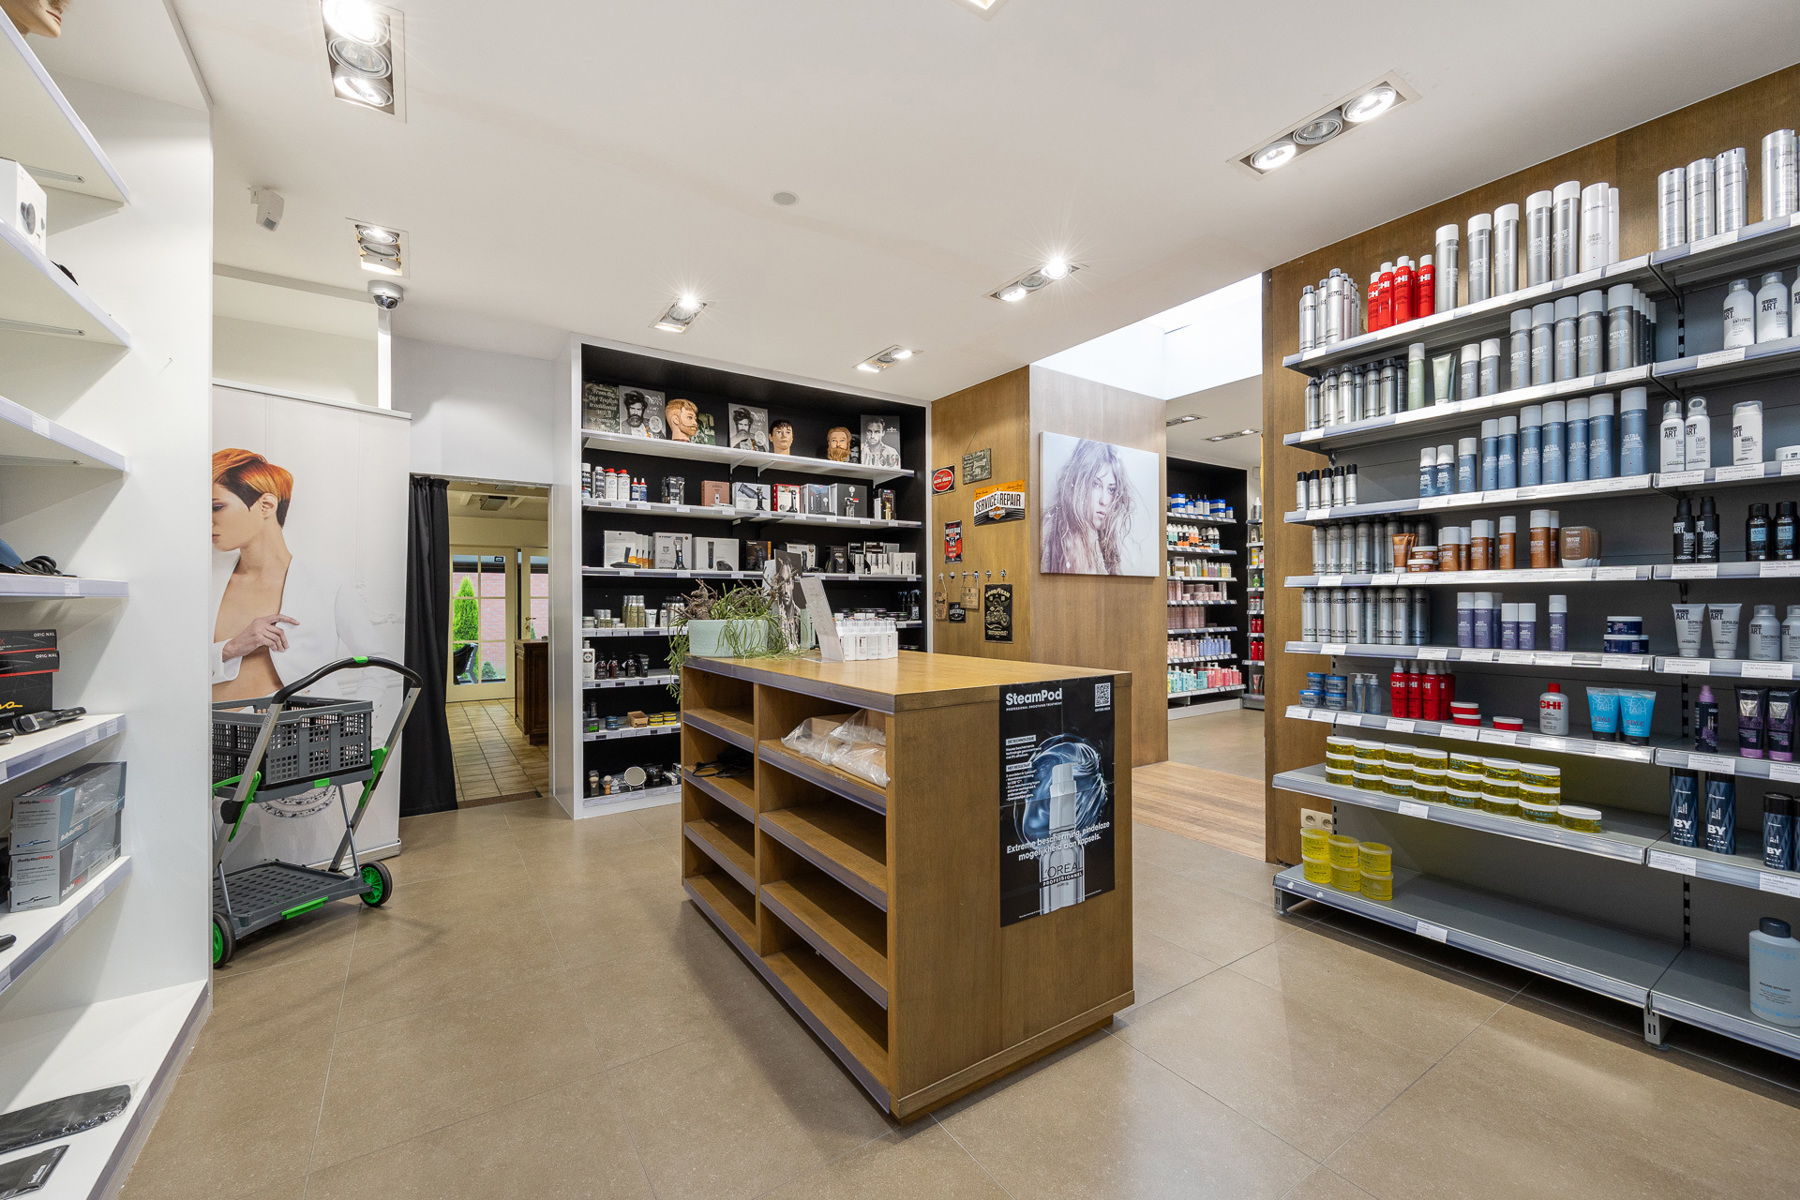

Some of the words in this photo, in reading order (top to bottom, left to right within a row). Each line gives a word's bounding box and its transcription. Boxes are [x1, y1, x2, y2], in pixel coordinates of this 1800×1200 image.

[1394, 275, 1408, 285] CHI
[975, 493, 997, 514] SERVICE
[1000, 492, 1021, 507] REPAIR
[1006, 687, 1063, 706] SteamPod
[1592, 695, 1615, 704] SEXY
[1540, 700, 1562, 710] CHI
[1625, 697, 1649, 707] SEXY
[1592, 703, 1615, 712] HAIR
[1624, 706, 1647, 715] HAIR
[1594, 715, 1611, 723] STYLE
[1626, 719, 1643, 727] STYLE
[1673, 818, 1692, 829] BY
[1707, 824, 1726, 835] BY
[1006, 841, 1036, 854] Extreme
[1037, 830, 1082, 845] bescherming,
[1082, 821, 1110, 835] eindeloze
[1063, 841, 1077, 849] aan
[1078, 833, 1101, 847] kapsels.
[1766, 847, 1782, 856] BY
[1041, 861, 1083, 880] L'ORÉAL
[1042, 872, 1083, 887] PROFESSIONNEL
